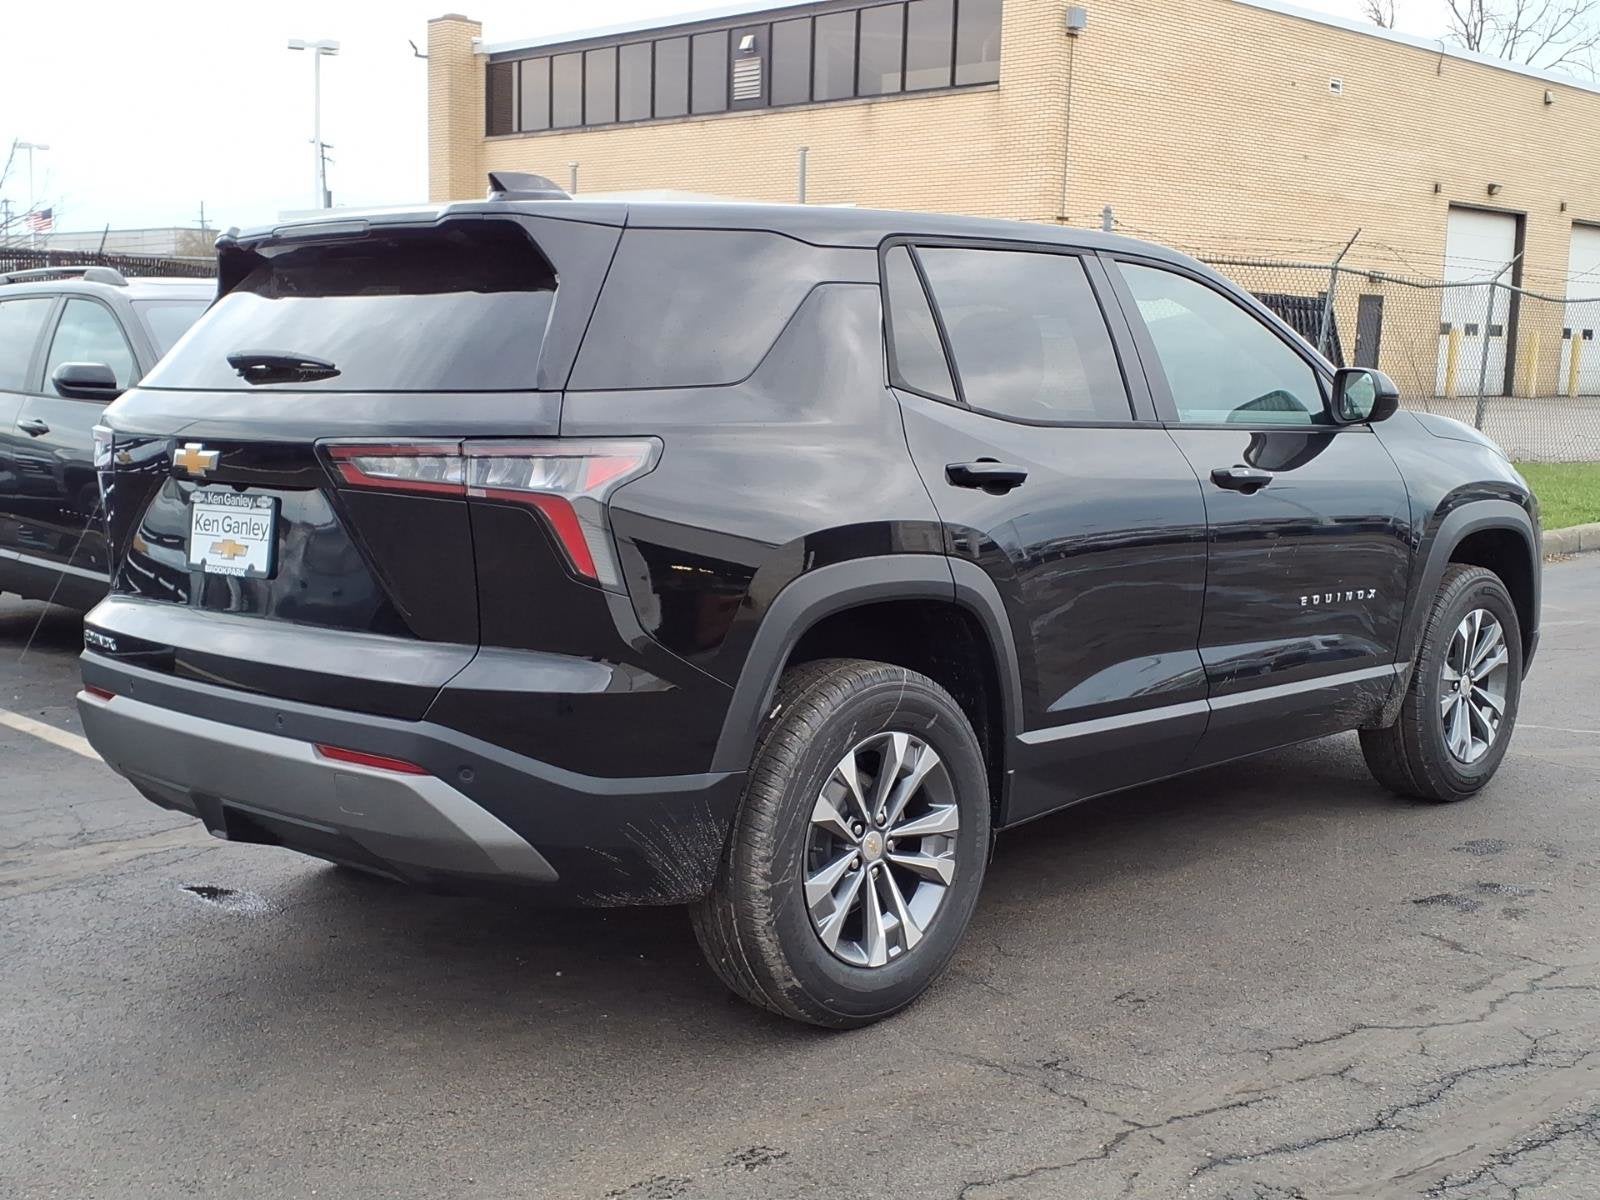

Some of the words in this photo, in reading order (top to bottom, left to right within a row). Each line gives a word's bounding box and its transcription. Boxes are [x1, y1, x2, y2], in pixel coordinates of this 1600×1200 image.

[194, 512, 219, 533] Ken
[221, 515, 269, 542] Ganley
[1300, 588, 1376, 606] EQUINOX
